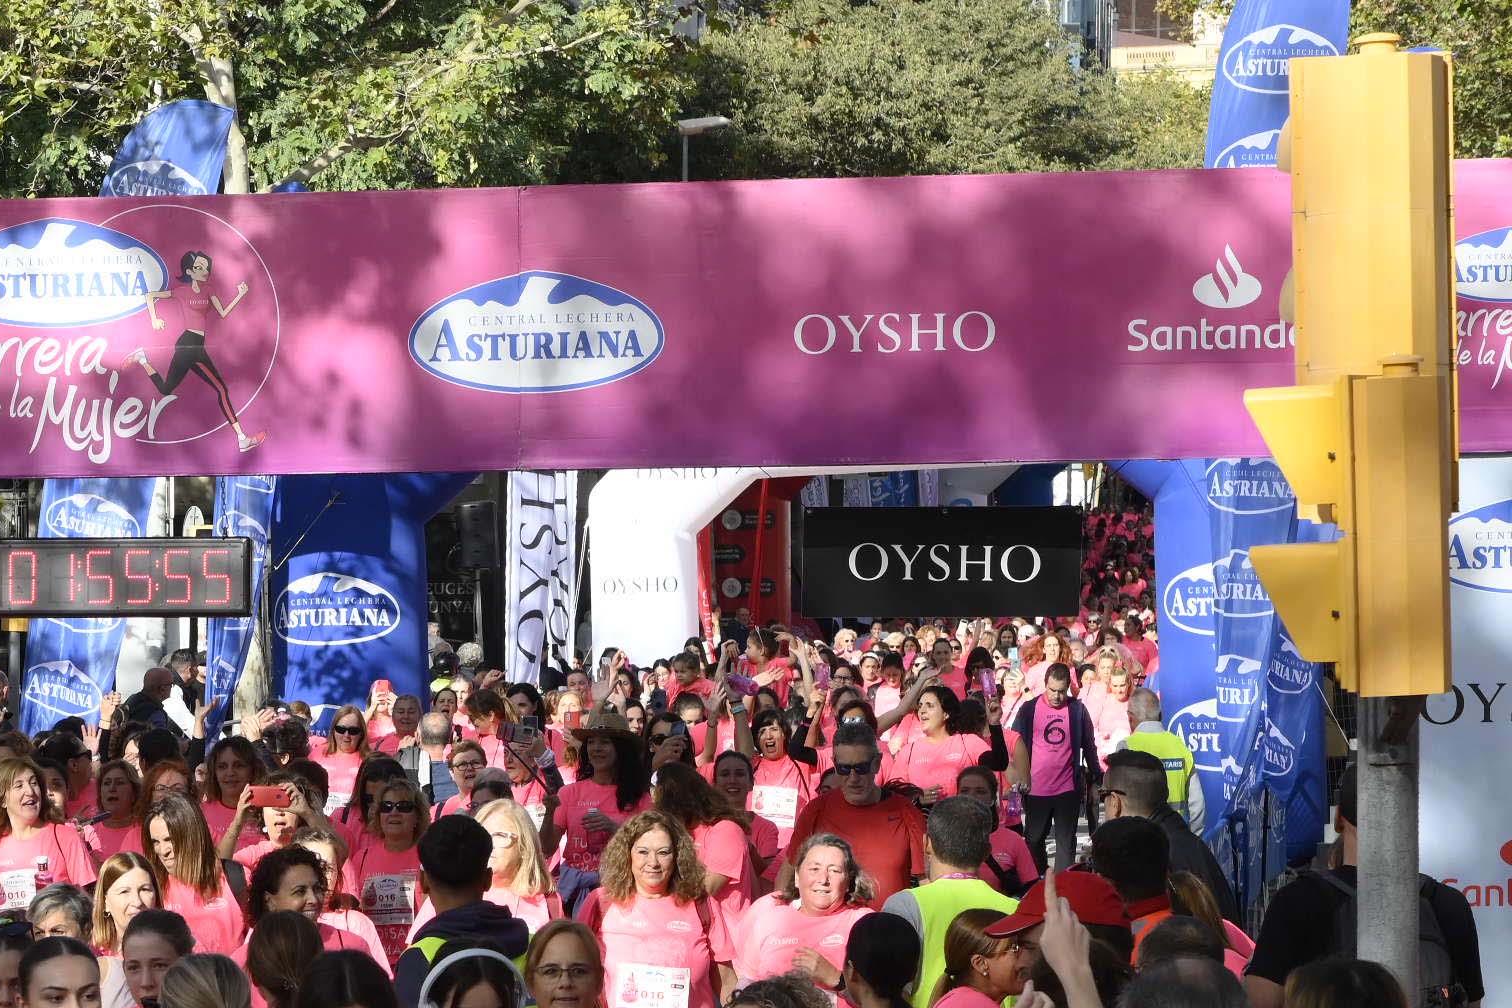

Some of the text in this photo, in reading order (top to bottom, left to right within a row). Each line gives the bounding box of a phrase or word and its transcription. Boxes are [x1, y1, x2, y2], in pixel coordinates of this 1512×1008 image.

[1232, 51, 1289, 77] ASTUR
[468, 311, 637, 327] CENTRAL LECHERA
[794, 309, 996, 356] OYSHO
[428, 316, 645, 363] ASTURIANA
[1127, 317, 1296, 352] Santand
[9, 379, 34, 419] la
[29, 369, 178, 465] Mujer
[848, 542, 1042, 584] OYSHO
[278, 601, 392, 630] ASTURIANA
[290, 598, 334, 606] CENTRAL
[1042, 717, 1067, 746] 6
[1189, 722, 1217, 730] CENT
